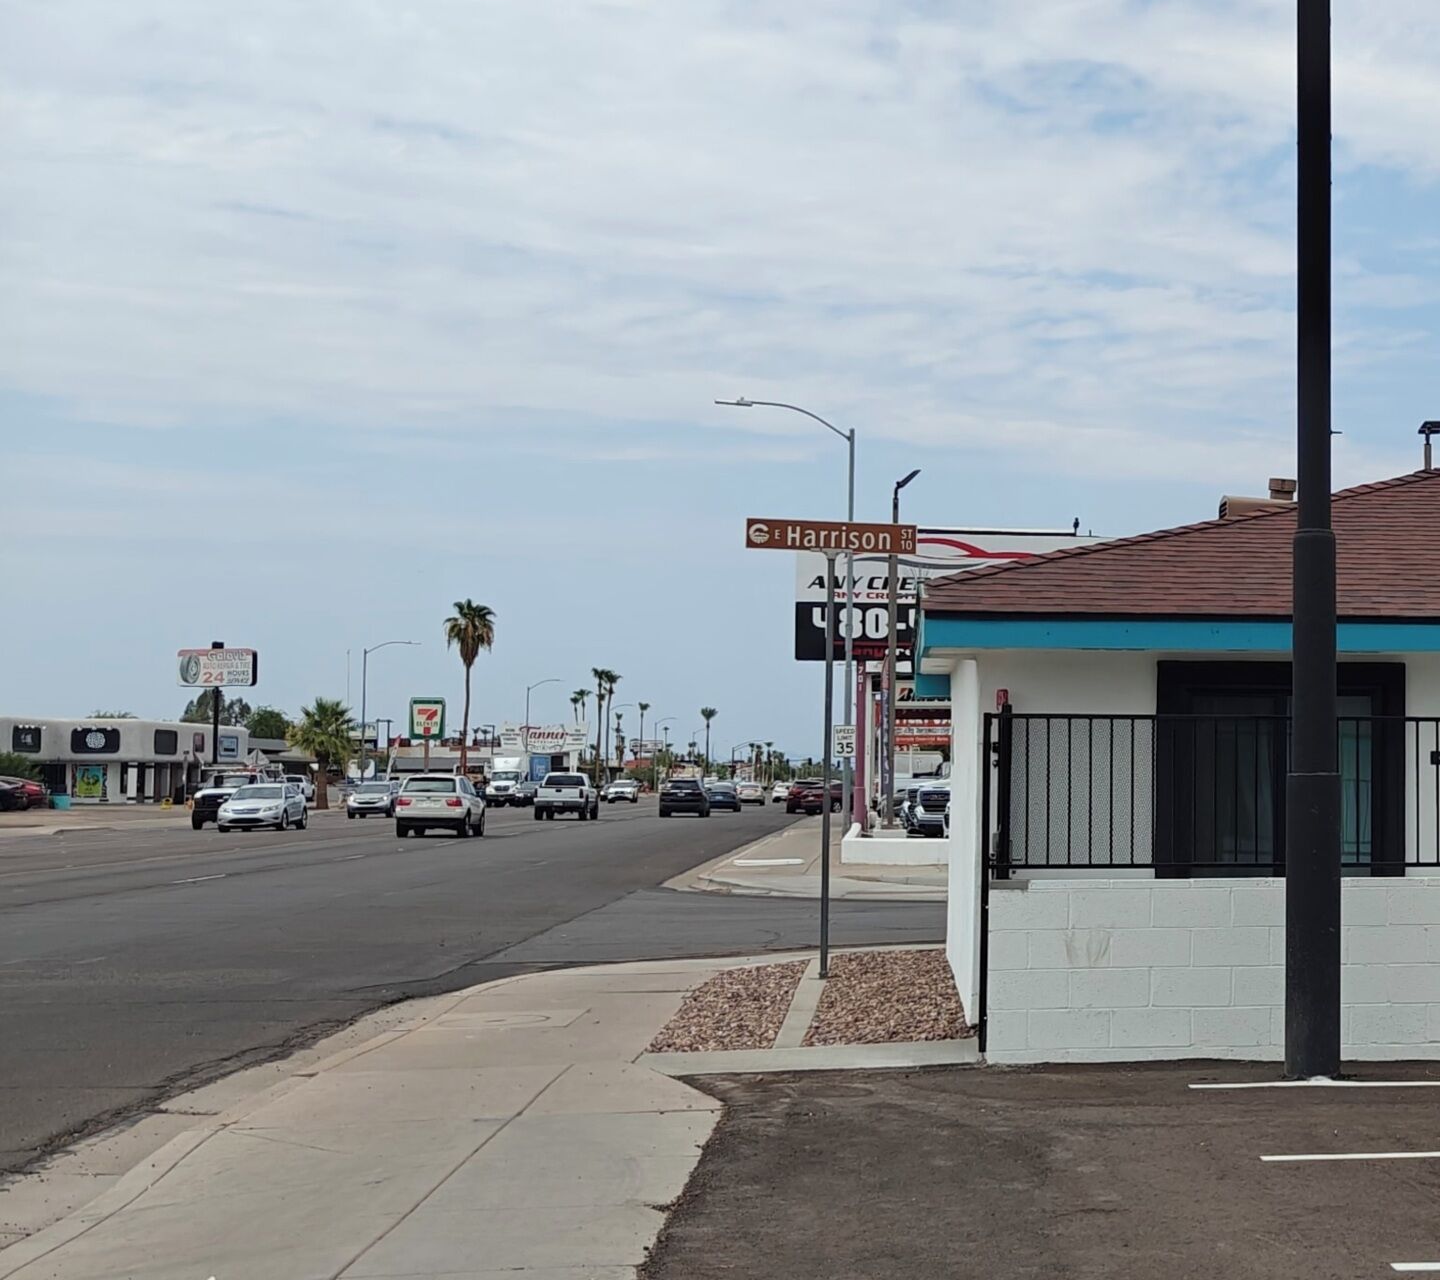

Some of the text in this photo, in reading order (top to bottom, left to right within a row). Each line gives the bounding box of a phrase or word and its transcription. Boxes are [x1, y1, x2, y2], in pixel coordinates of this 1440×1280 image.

[774, 525, 891, 550] E Harrison
[901, 529, 913, 539] ST
[901, 540, 913, 551] 10
[202, 671, 225, 684] 24
[417, 708, 438, 735] 7
[836, 742, 854, 754] 35
